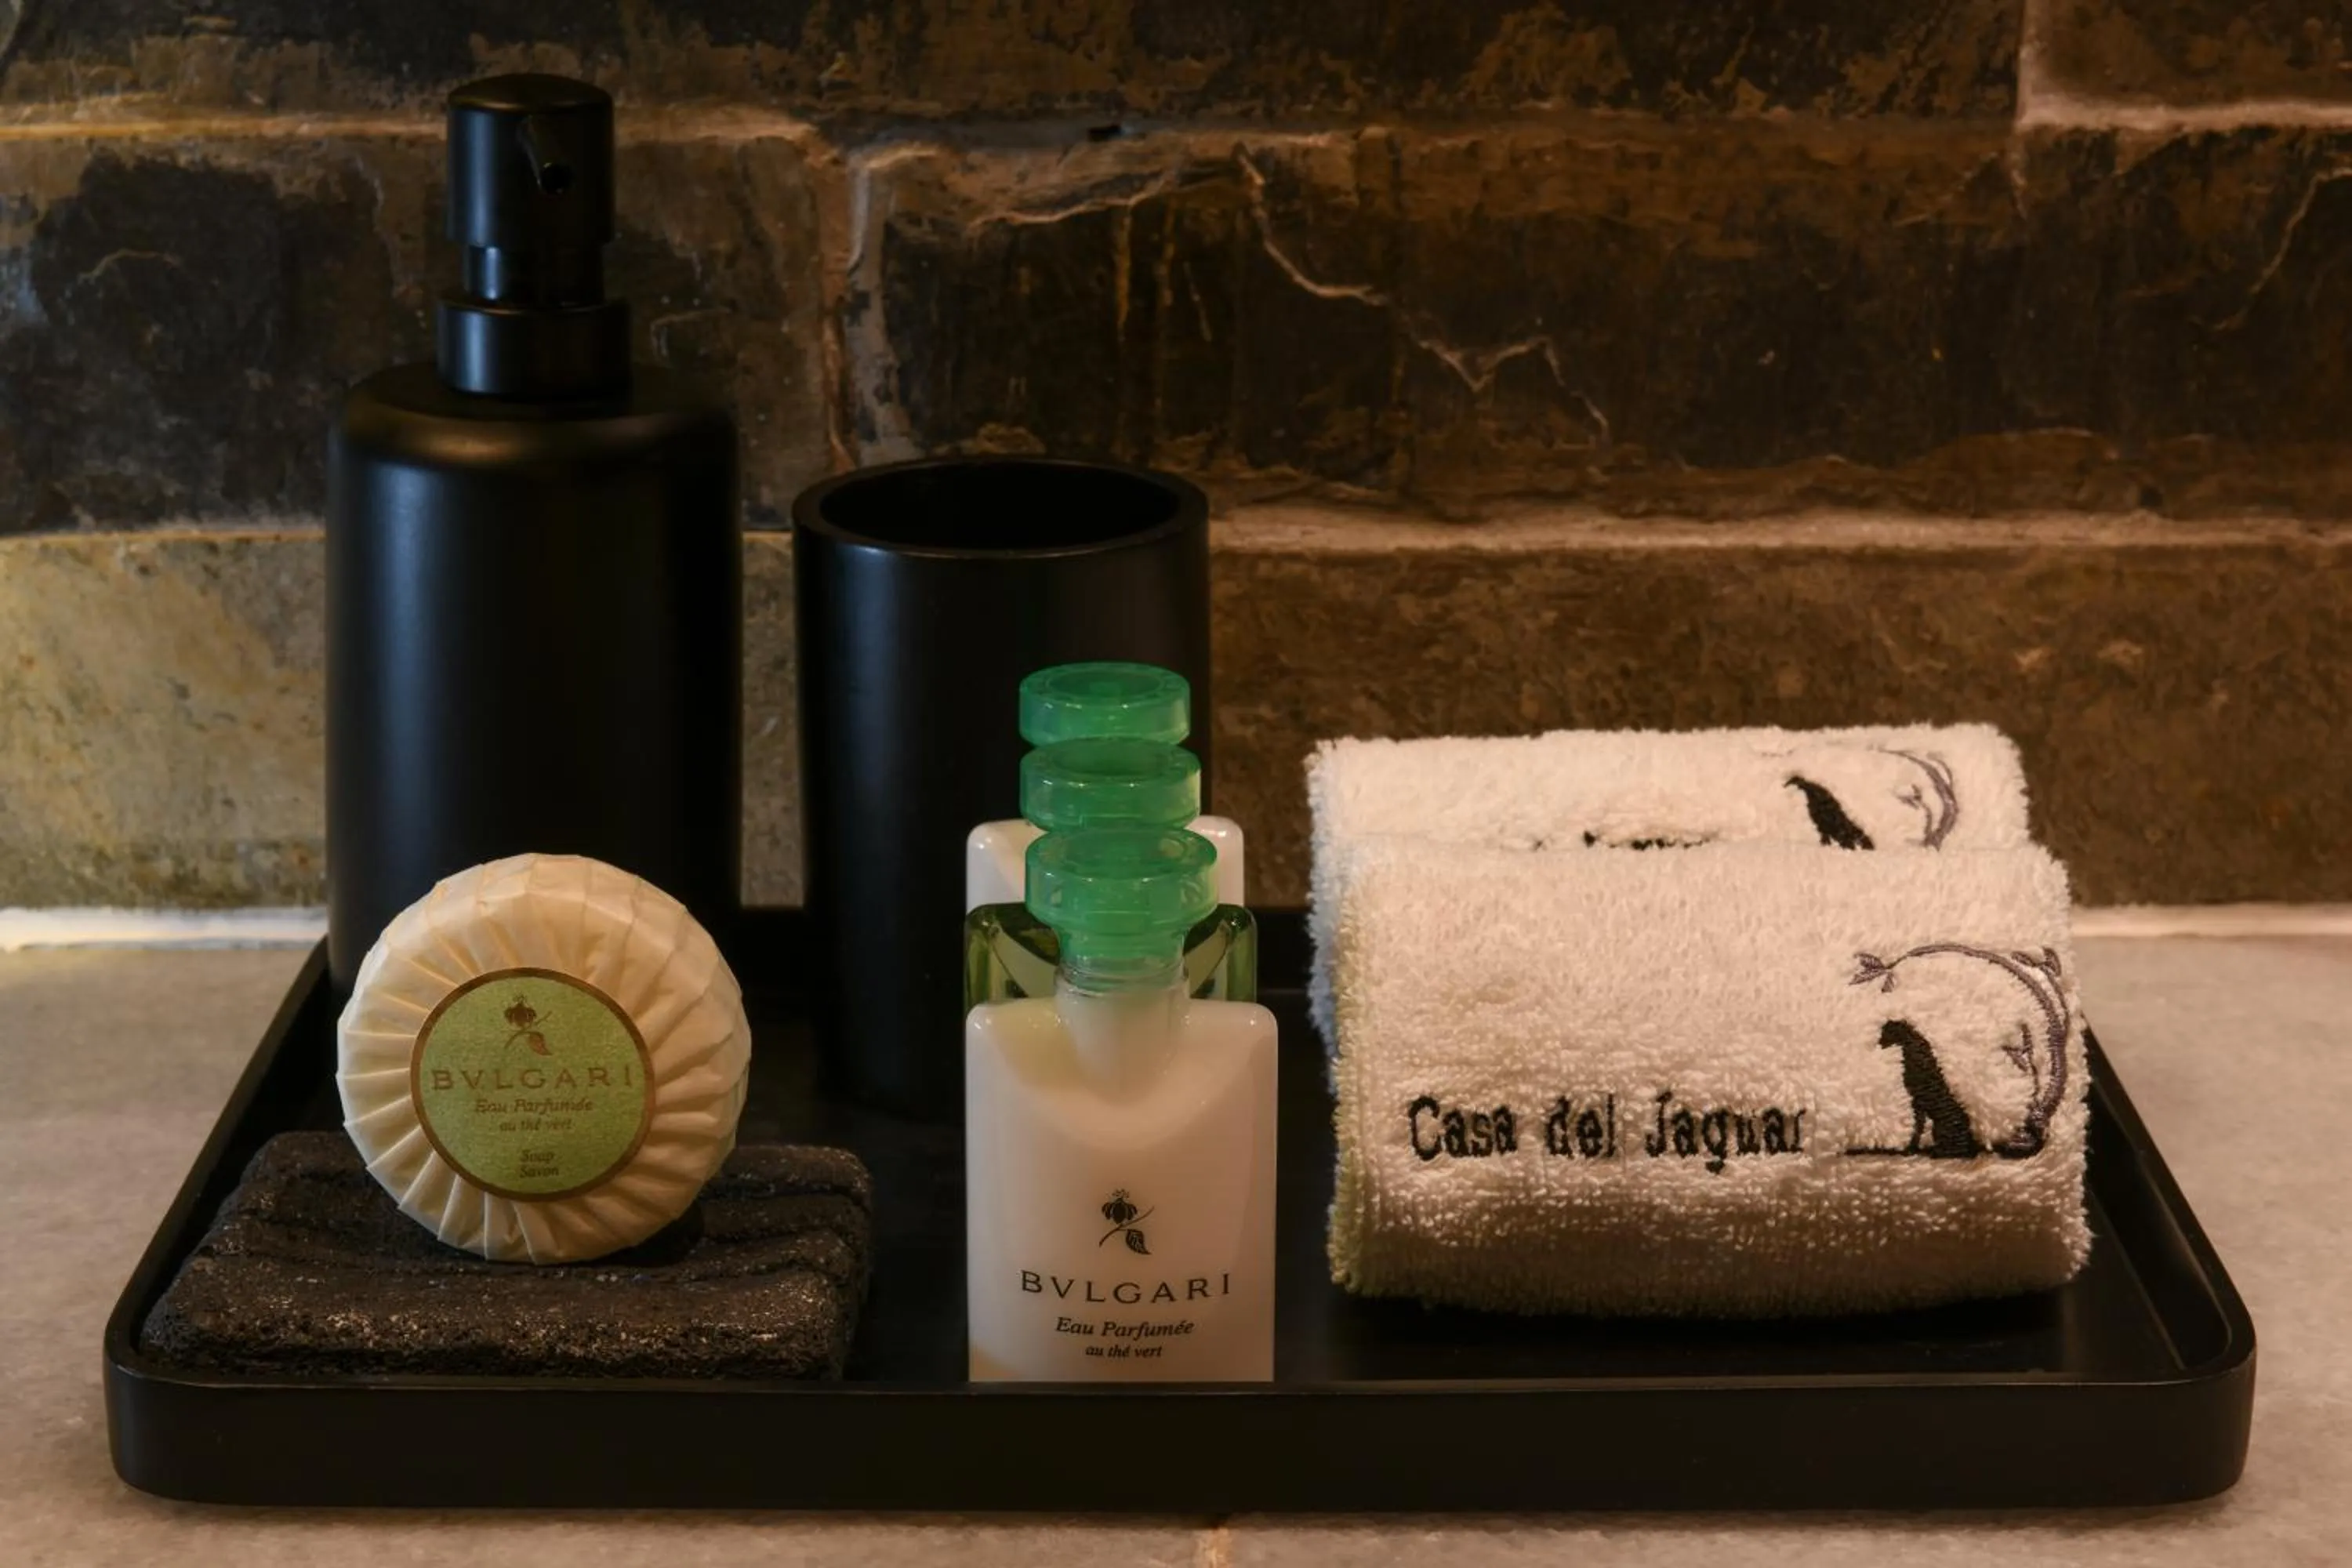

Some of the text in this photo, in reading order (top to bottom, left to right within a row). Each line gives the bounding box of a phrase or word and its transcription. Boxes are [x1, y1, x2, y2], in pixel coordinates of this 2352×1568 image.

[432, 1064, 633, 1091] BVLGARI
[475, 1099, 506, 1113] Eau
[547, 1117, 573, 1131] vert
[1409, 1091, 1806, 1174] Casa del Jaguar
[520, 1149, 555, 1163] Soap
[520, 1165, 559, 1178] Savon
[1020, 1269, 1230, 1305] BVLGARI
[1055, 1316, 1195, 1341] Eau Parfumée
[1085, 1345, 1163, 1359] au thé vert
